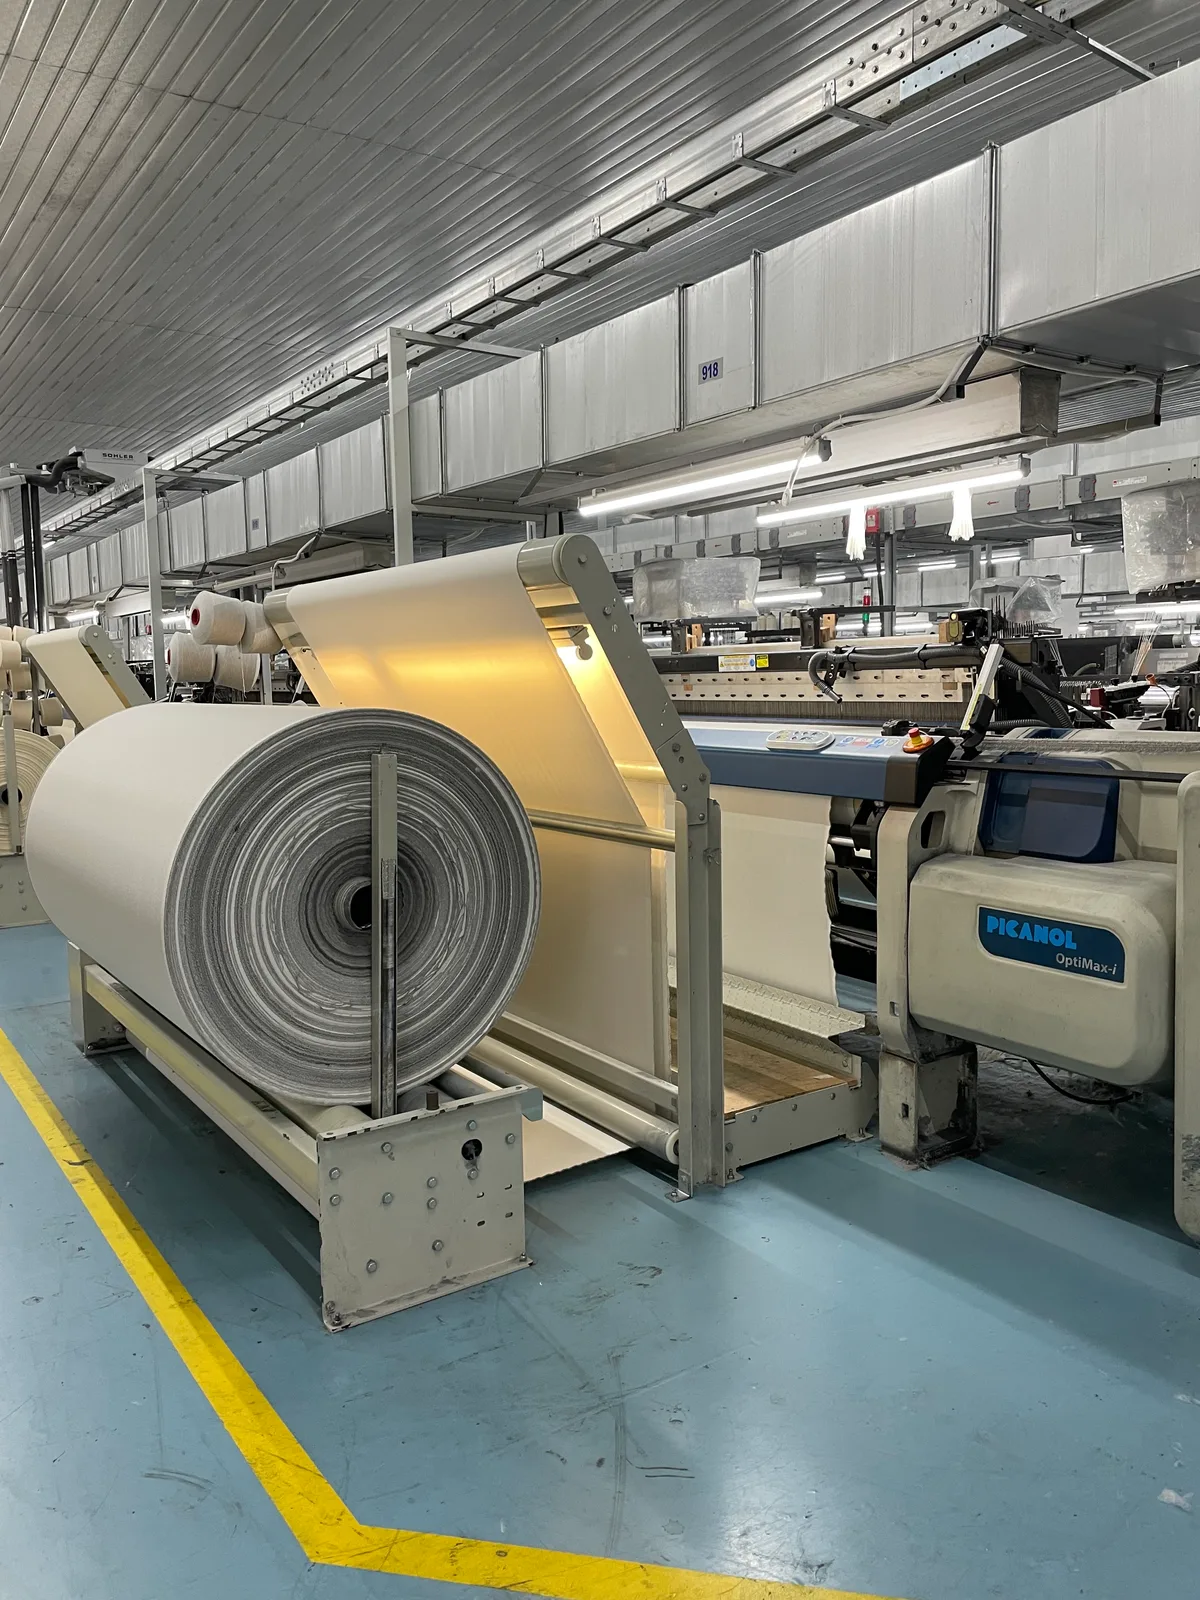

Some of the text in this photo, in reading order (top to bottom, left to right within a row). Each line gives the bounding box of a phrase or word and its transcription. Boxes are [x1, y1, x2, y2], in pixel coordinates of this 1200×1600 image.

[702, 361, 719, 381] 918
[986, 915, 1077, 950] PICANOL
[1055, 952, 1117, 975] OptiMax-i
